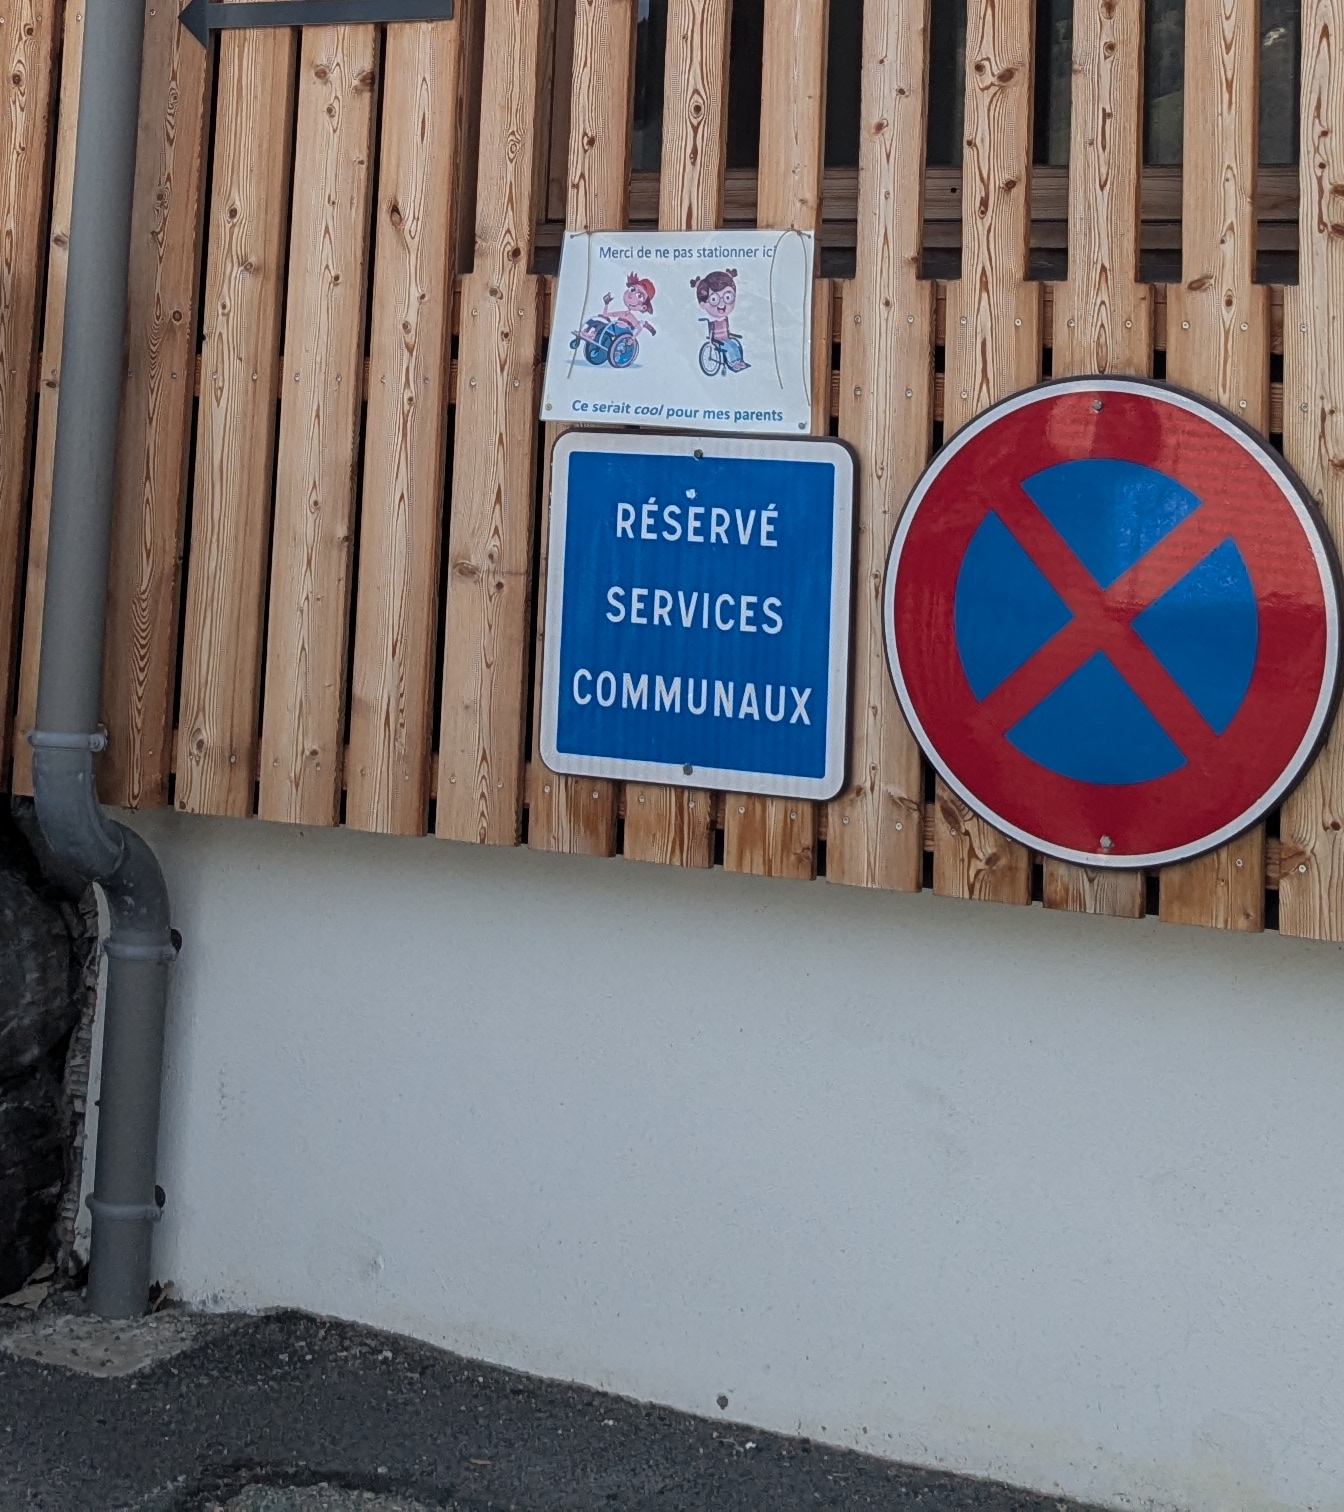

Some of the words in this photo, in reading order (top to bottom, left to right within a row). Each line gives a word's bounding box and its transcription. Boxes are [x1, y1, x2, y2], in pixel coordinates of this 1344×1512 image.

[599, 246, 634, 259] Merci
[637, 246, 652, 259] de
[655, 248, 670, 259] ne
[673, 248, 694, 261] pas
[696, 246, 759, 259] stationner
[762, 245, 776, 258] ici
[571, 399, 589, 412] Ce
[592, 401, 631, 415] serait
[634, 404, 664, 416] cool
[666, 407, 699, 421] pour
[702, 409, 731, 421] mes
[734, 408, 784, 423] parents
[616, 497, 778, 547] RÉSERVÉ
[606, 586, 783, 634] SERVICES
[573, 668, 812, 725] COMMUNAUX
